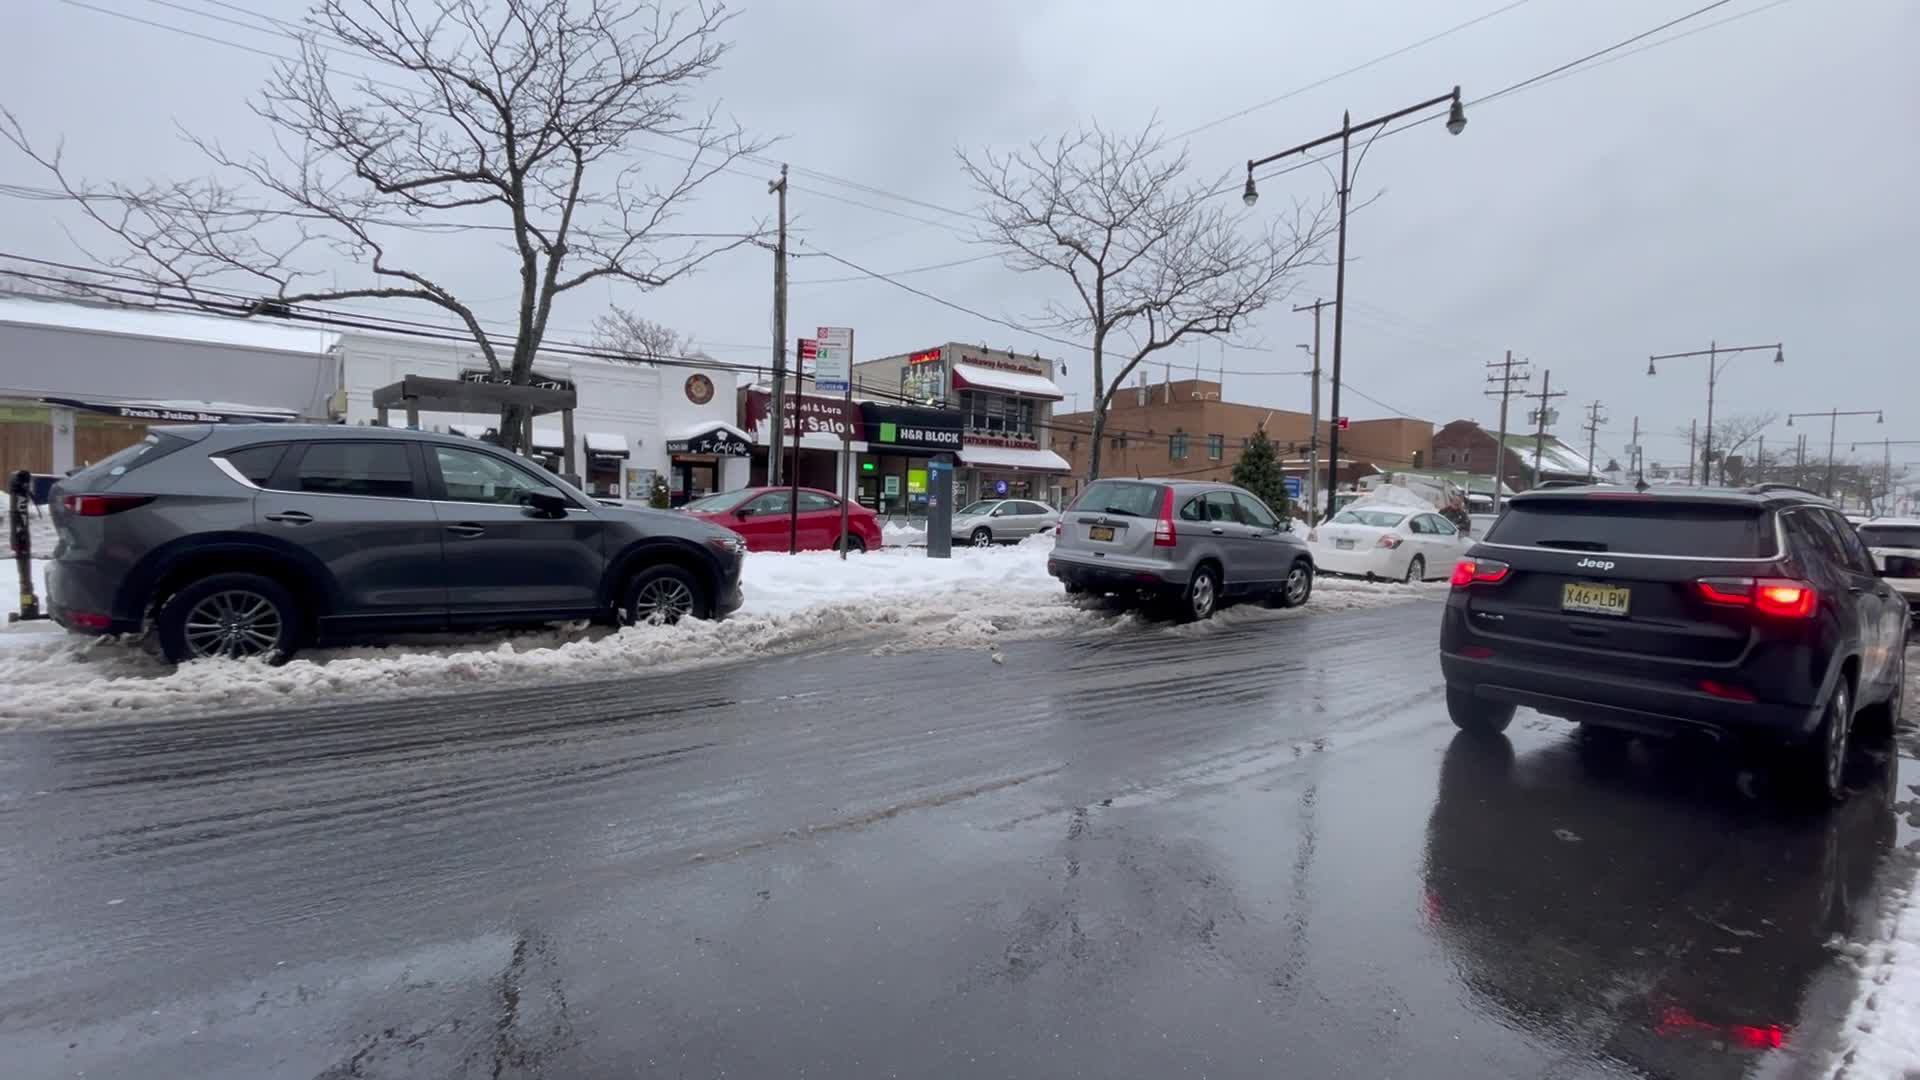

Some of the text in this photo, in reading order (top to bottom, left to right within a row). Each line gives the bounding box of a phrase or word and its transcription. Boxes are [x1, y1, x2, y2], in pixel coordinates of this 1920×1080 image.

[121, 407, 222, 422] Fresh Juice Bar
[900, 428, 959, 443] H&R BLOCK
[701, 440, 712, 452] The
[1577, 558, 1615, 571] Jeep
